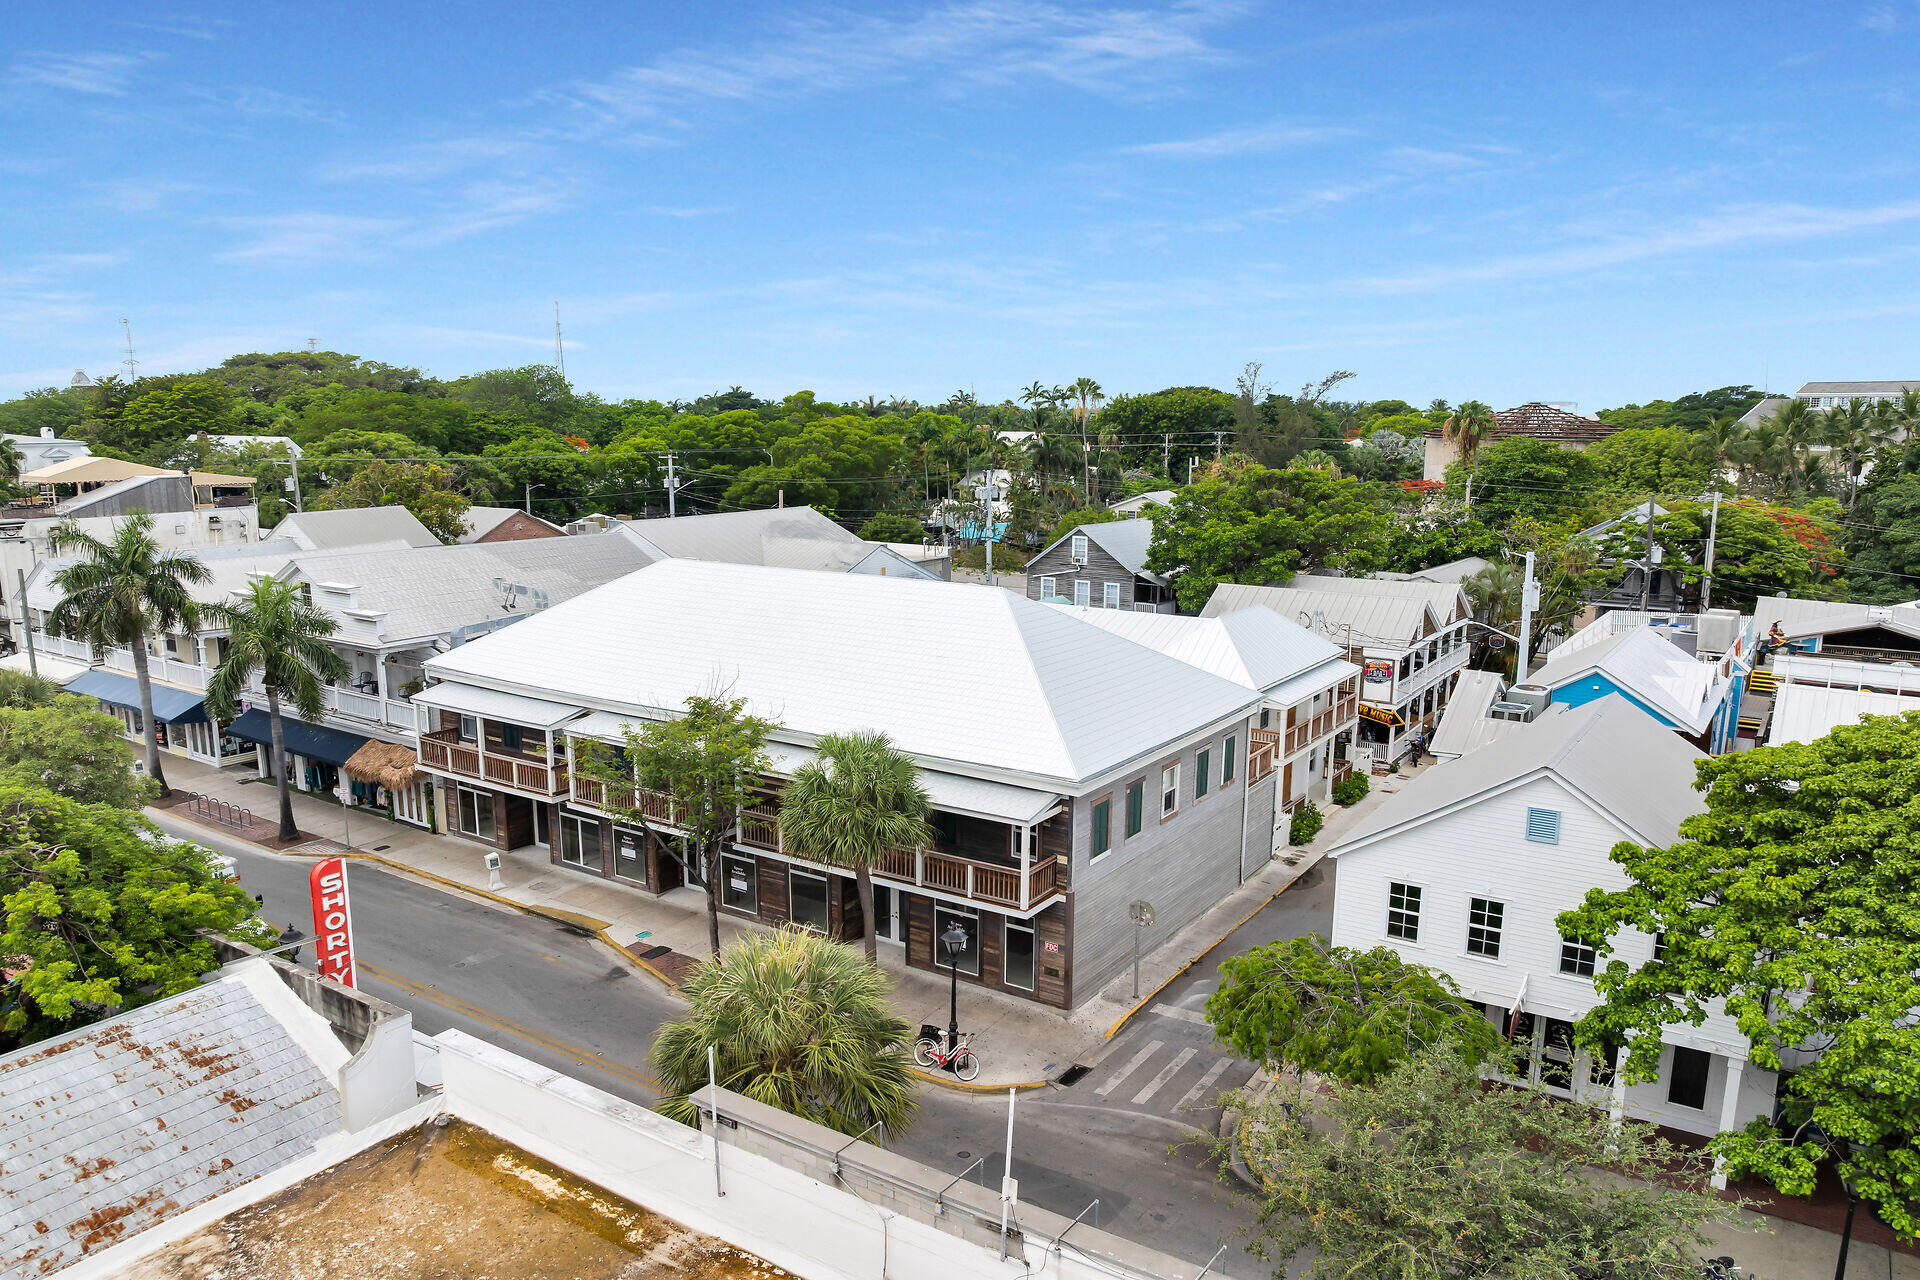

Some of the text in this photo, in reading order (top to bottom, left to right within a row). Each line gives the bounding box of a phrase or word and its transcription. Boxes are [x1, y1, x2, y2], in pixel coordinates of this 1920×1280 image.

[1368, 708, 1394, 724] MUSIC
[320, 872, 350, 985] SHORTY
[1045, 942, 1058, 952] FDC
